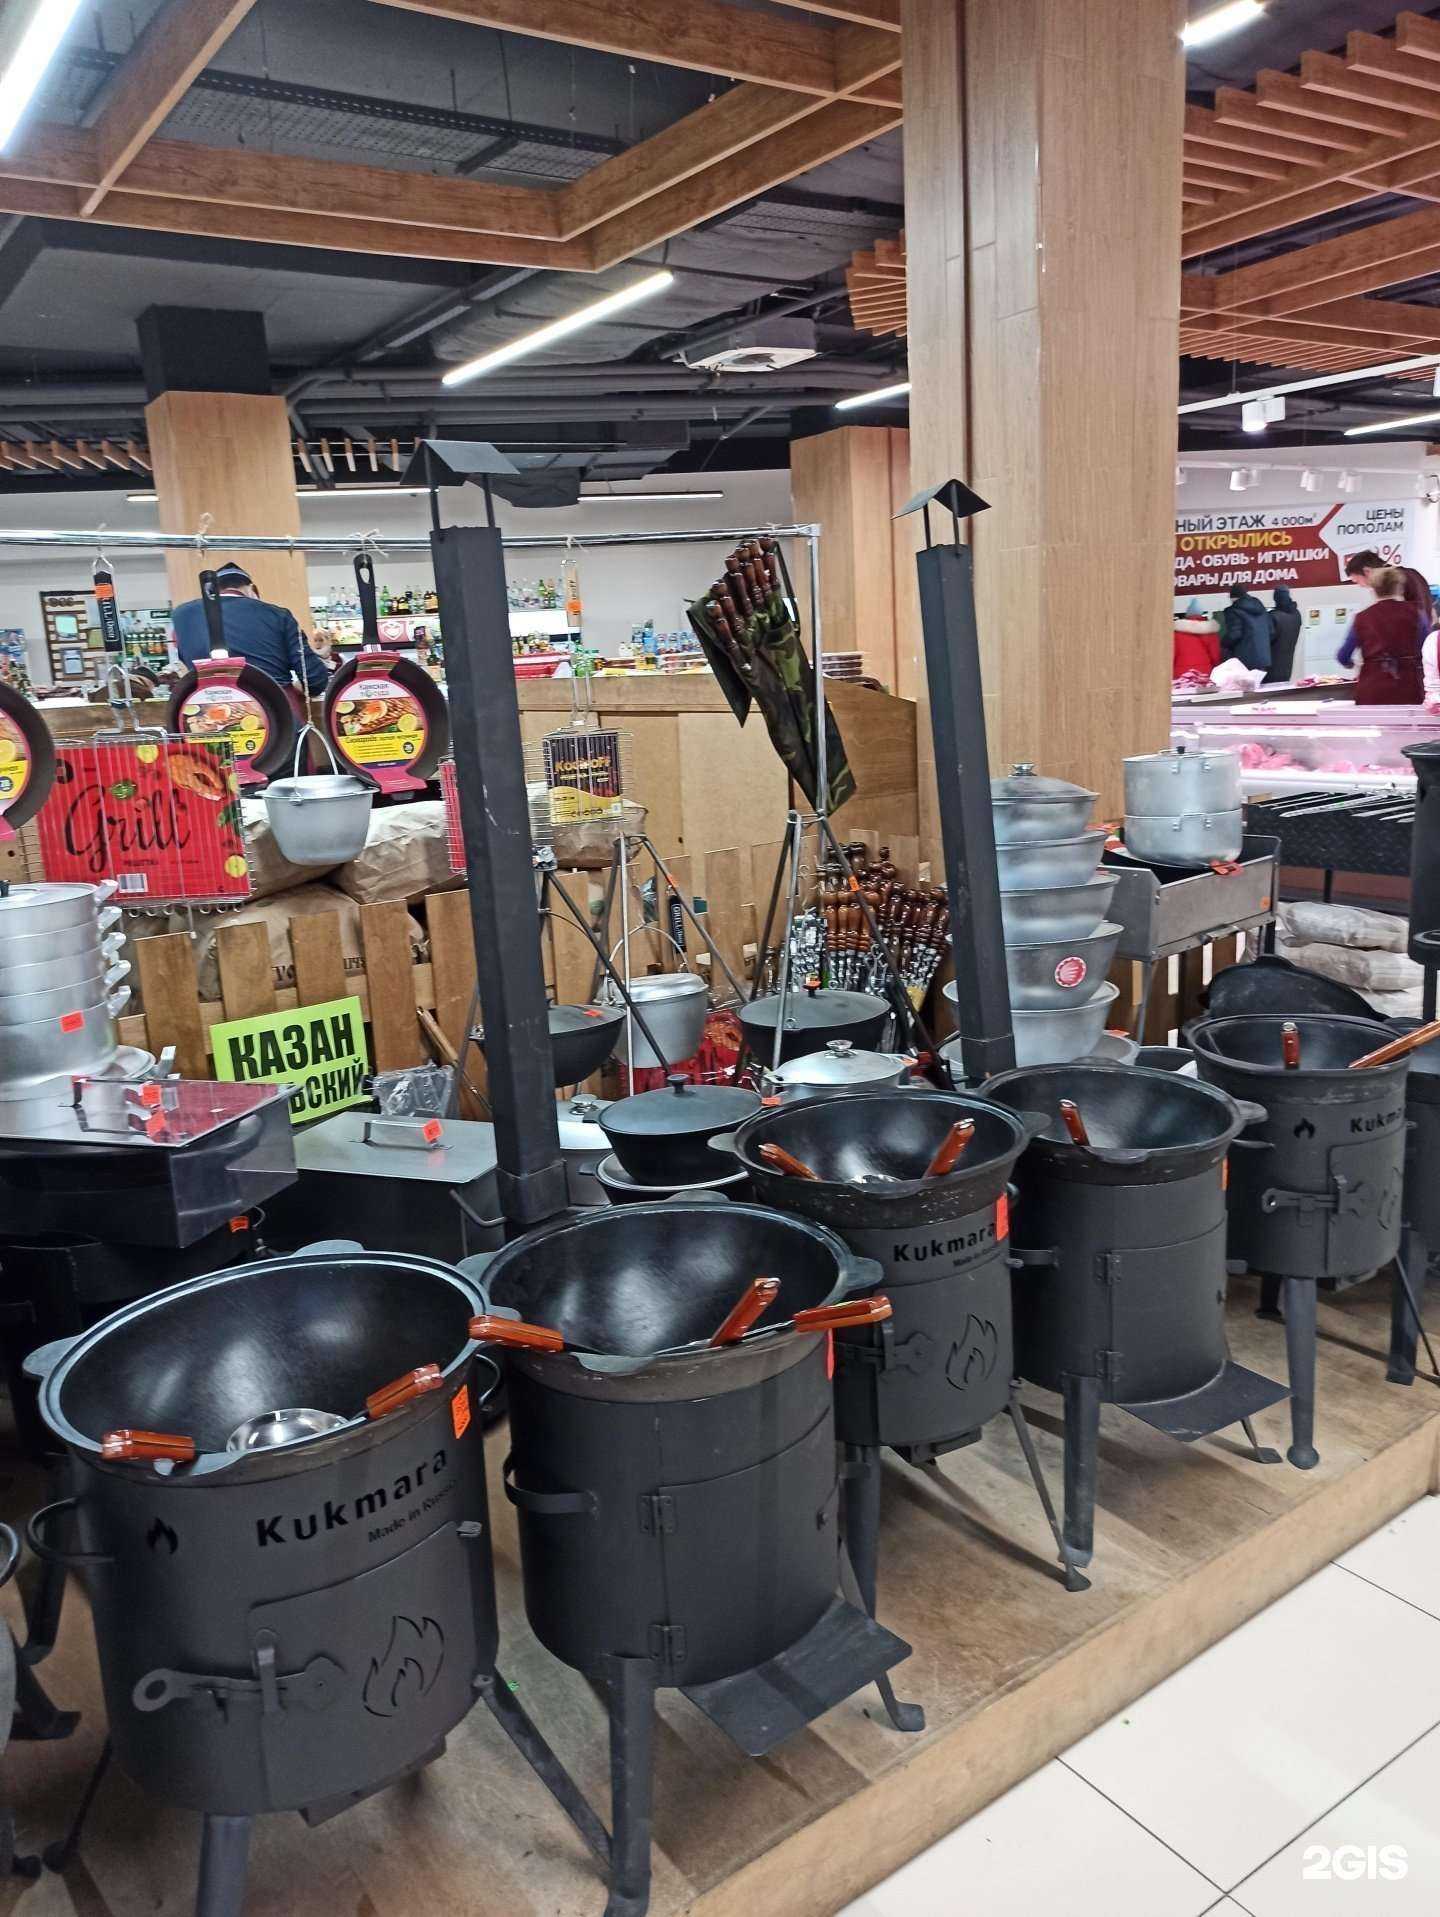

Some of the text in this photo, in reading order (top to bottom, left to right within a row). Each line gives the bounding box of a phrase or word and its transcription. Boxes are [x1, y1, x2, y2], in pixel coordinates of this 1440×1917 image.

[1176, 515, 1212, 532] НЫЙ
[1216, 514, 1266, 530] ЭТАЖ
[1366, 508, 1404, 521] ЦЕНЫ
[1337, 522, 1404, 535] ПОПОЛАМ
[1181, 531, 1293, 552] ОТКРЫЛИСЬ
[1202, 552, 1249, 567] ОБУВЬ
[1258, 547, 1330, 564] ИГРУШКИ
[1220, 570, 1252, 586] ДЛЯ
[1253, 568, 1298, 584] ДОМА
[64, 783, 191, 873] Grill
[228, 1012, 355, 1082] КАЗАН
[893, 1223, 997, 1262] Kukmara
[256, 1449, 447, 1547] Kukmara
